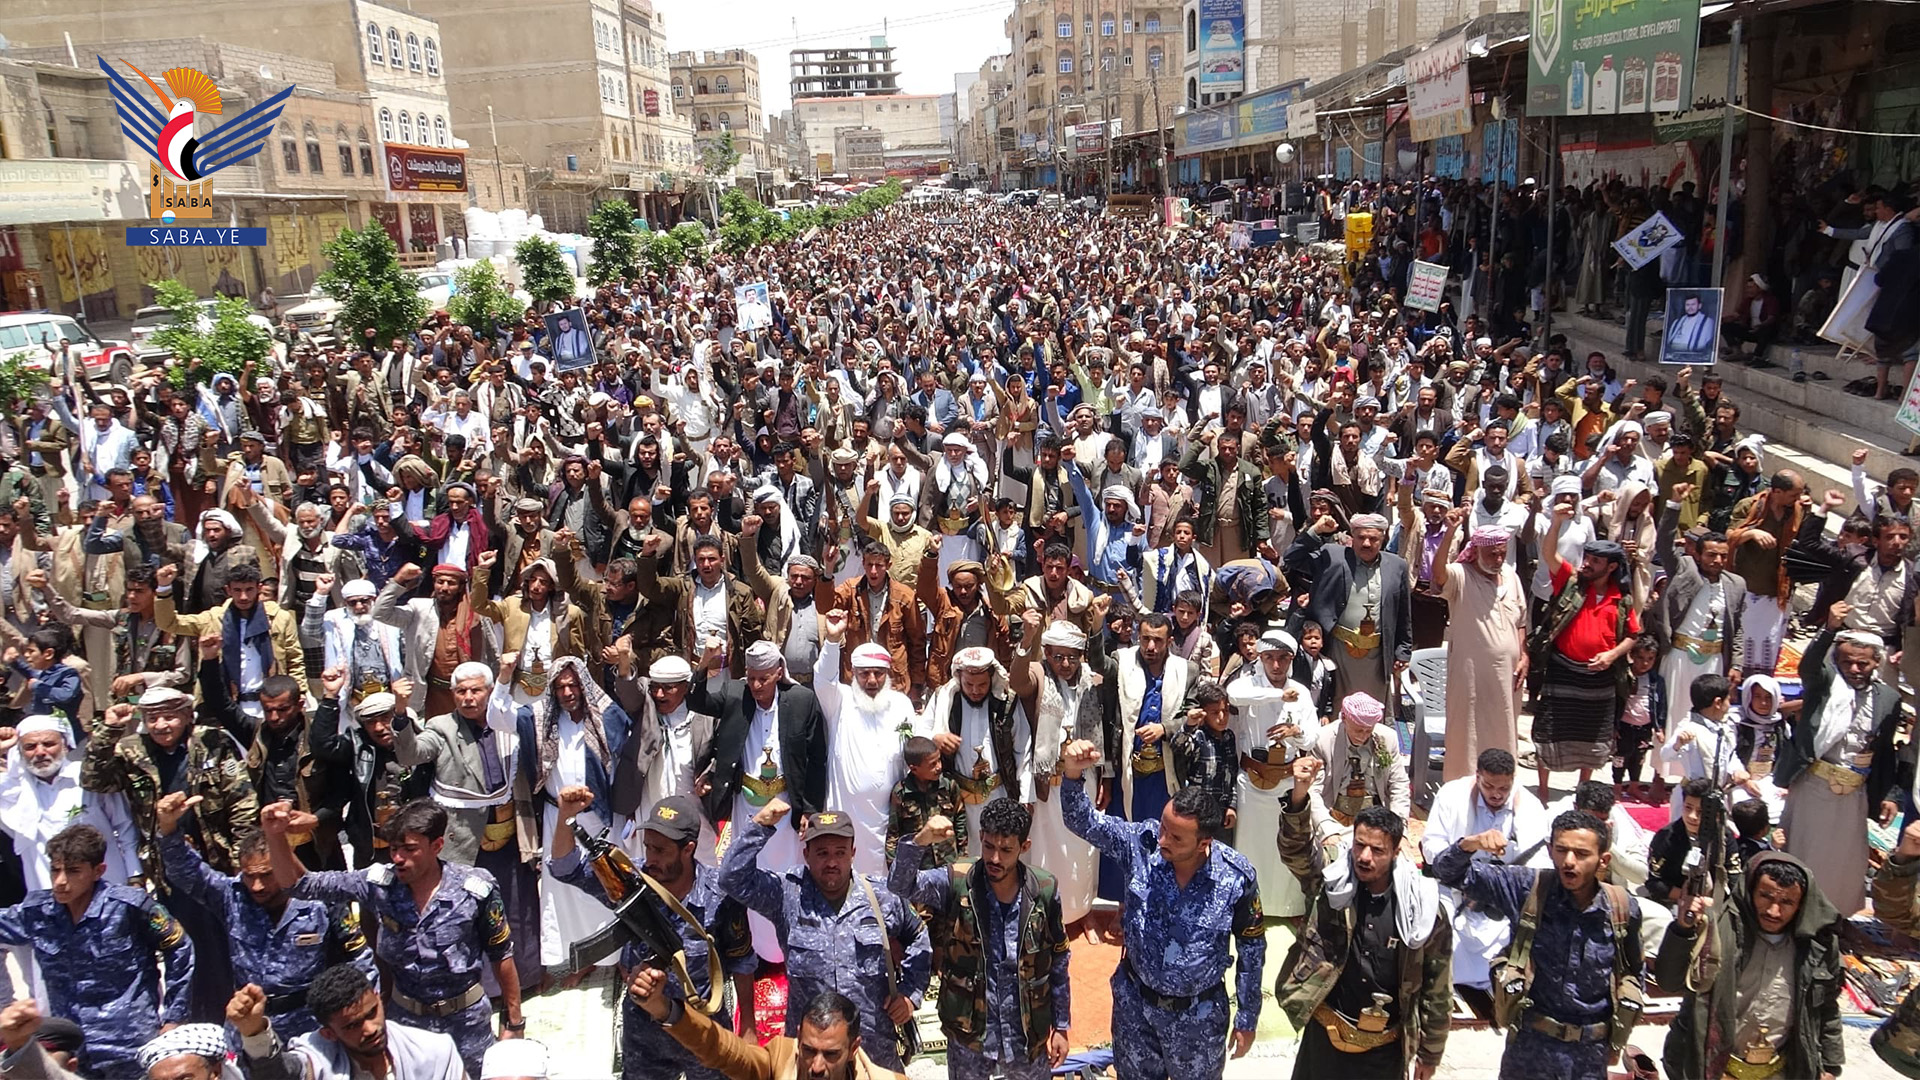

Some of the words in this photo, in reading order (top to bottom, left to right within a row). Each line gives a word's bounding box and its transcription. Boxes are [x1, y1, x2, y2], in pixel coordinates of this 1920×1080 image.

[1593, 34, 1603, 48] FOR
[1603, 27, 1639, 46] AGRICULTURAL
[1639, 18, 1682, 40] DEVELOPMENT
